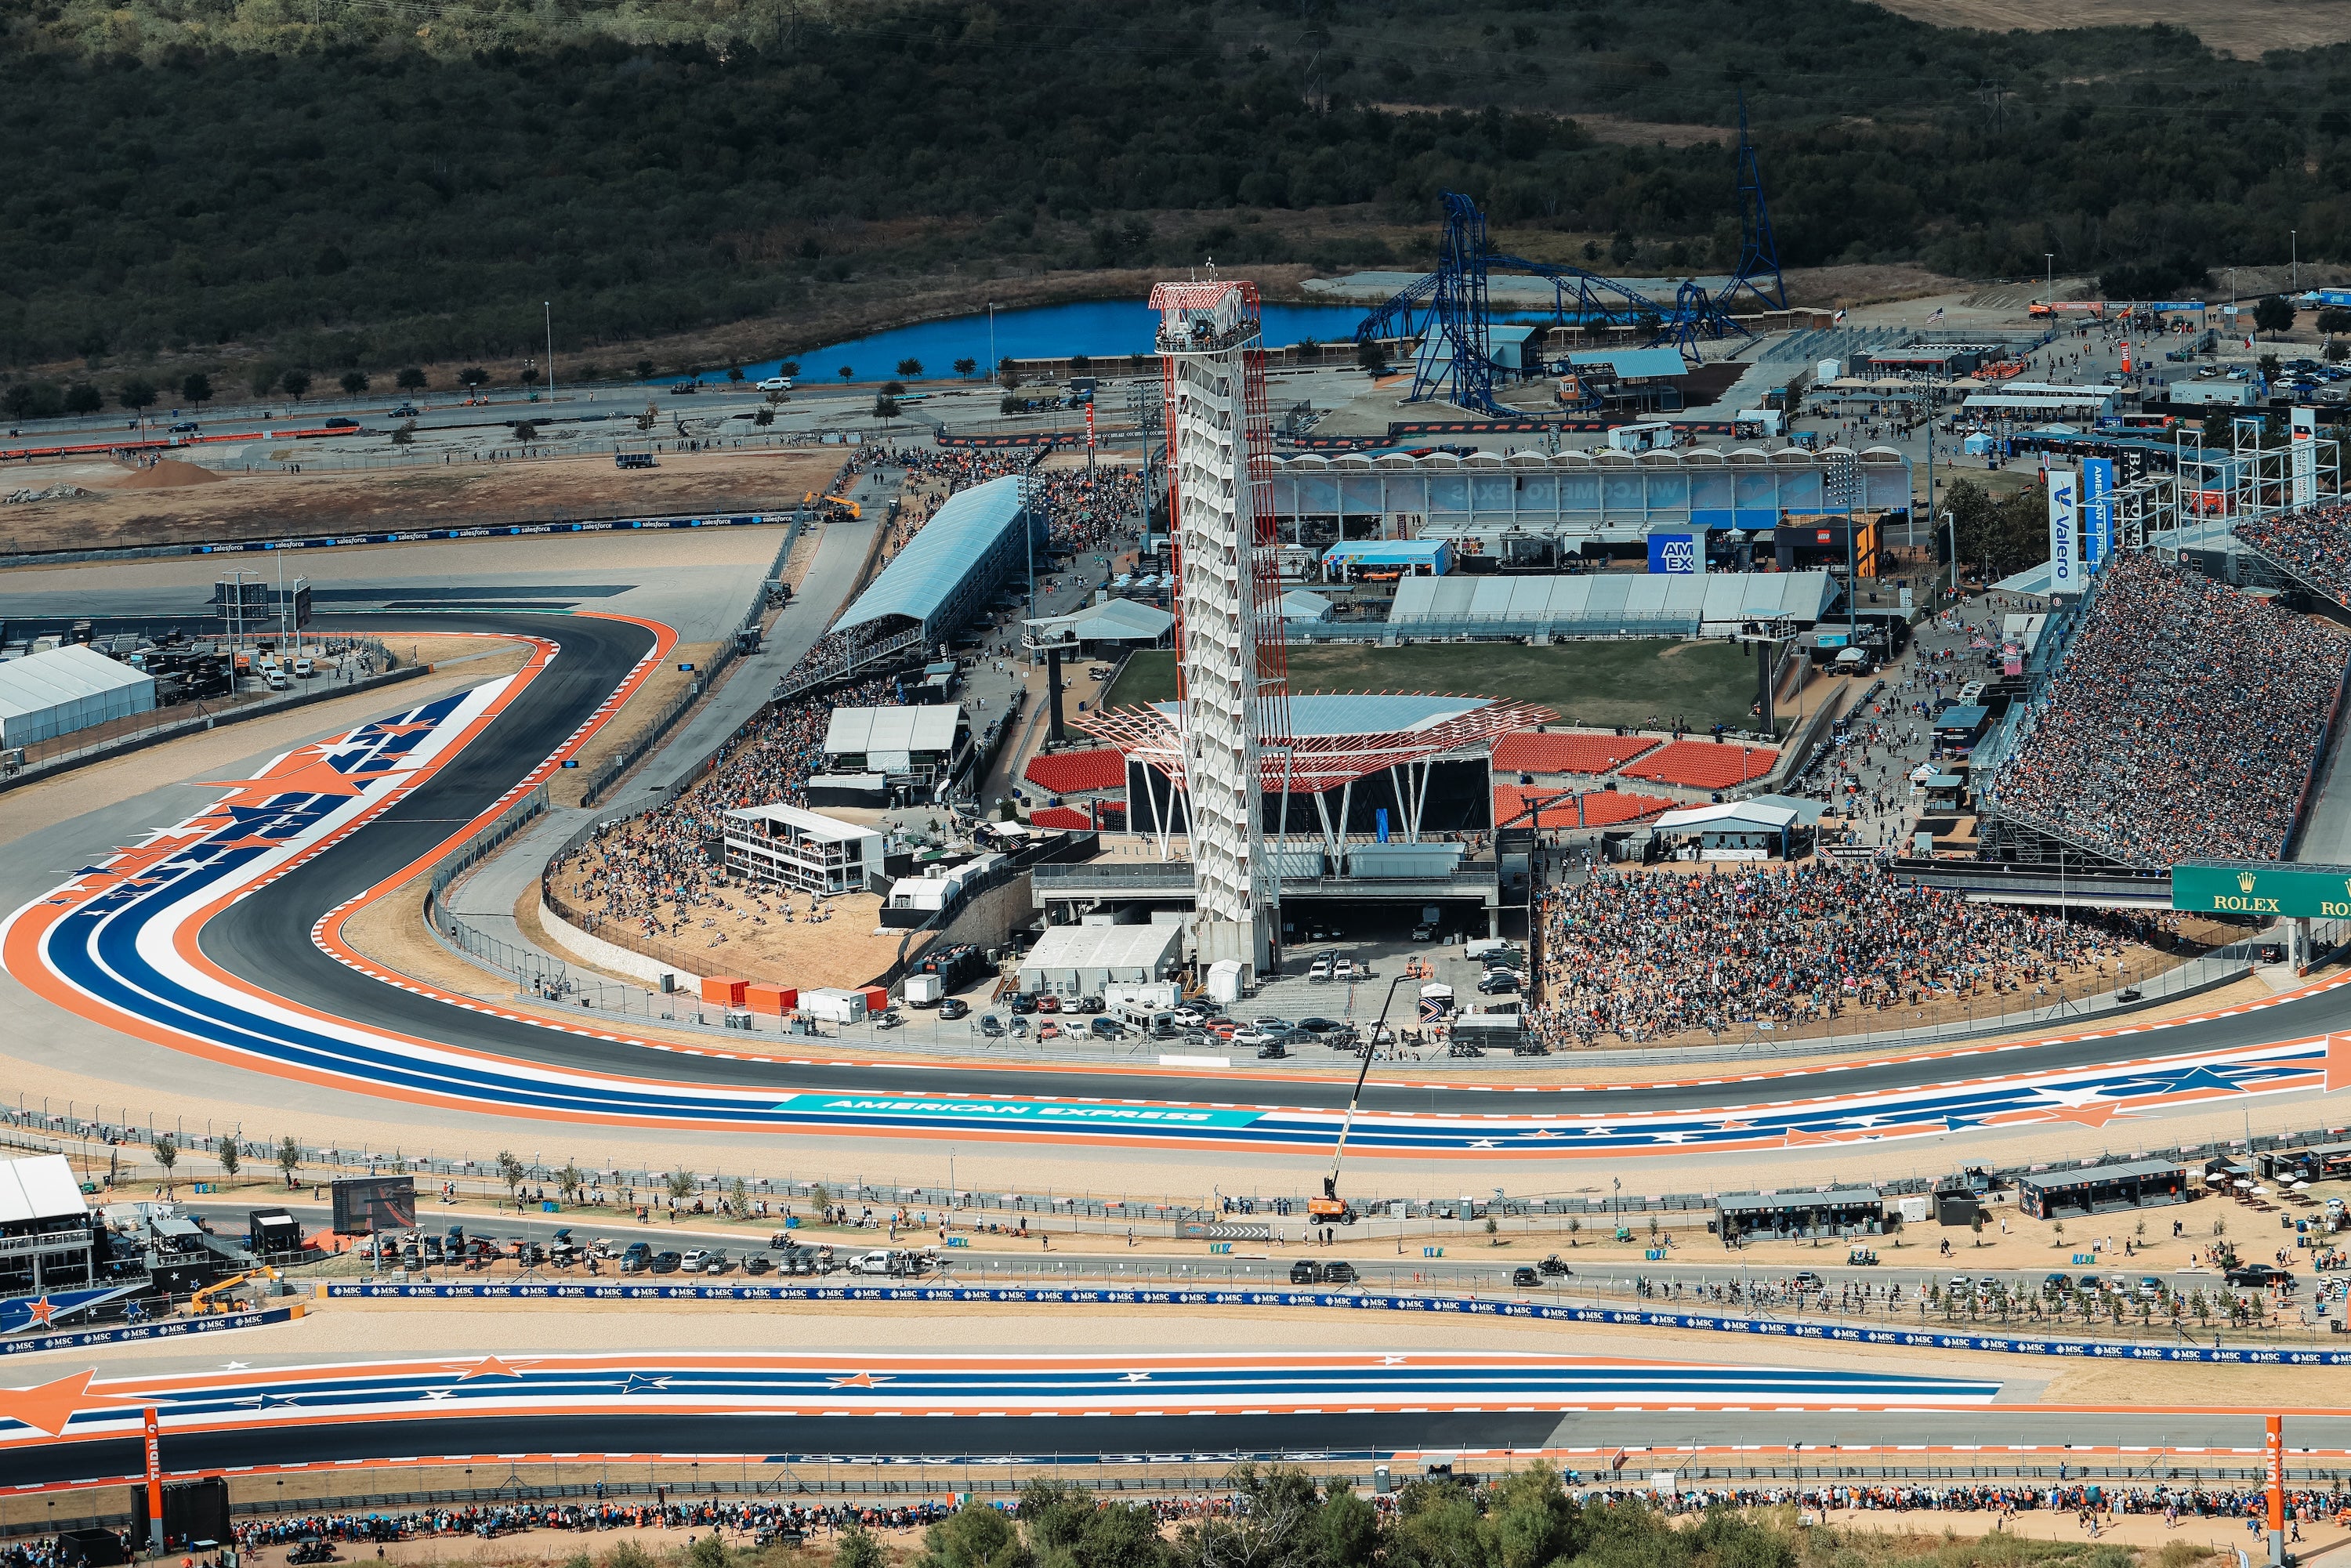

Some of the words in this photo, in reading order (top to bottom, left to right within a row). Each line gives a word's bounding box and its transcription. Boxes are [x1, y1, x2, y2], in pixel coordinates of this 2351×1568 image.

[2094, 465, 2103, 520] AMERCAN
[701, 518, 731, 527] salesforce
[459, 529, 490, 538] salesforce
[274, 541, 305, 550] salesforce
[336, 537, 367, 545] salesforce
[2056, 515, 2070, 579] Valero
[2213, 896, 2281, 913] ROLEX
[2320, 902, 2351, 916] RO
[821, 1099, 1030, 1115] AMERICAN
[1037, 1107, 1214, 1122] EXPRESS
[1513, 1305, 1532, 1314] MSC
[1550, 1309, 1568, 1317] MSC
[207, 1319, 225, 1328] MSC
[244, 1314, 263, 1324] MSC
[1658, 1315, 1677, 1324] MSC
[1695, 1318, 1714, 1327] MSC
[131, 1327, 149, 1337] MSC
[168, 1323, 187, 1332] MSC
[1768, 1324, 1787, 1332] MSC
[1804, 1326, 1822, 1334] MSC
[92, 1332, 111, 1341] MSC
[1841, 1329, 1860, 1338] MSC
[1877, 1332, 1896, 1341] MSC
[16, 1341, 34, 1349] MSC
[54, 1336, 73, 1345] MSC
[1951, 1338, 1969, 1346] MSC
[1990, 1340, 2009, 1349] MSC
[799, 1456, 955, 1465] MSC
